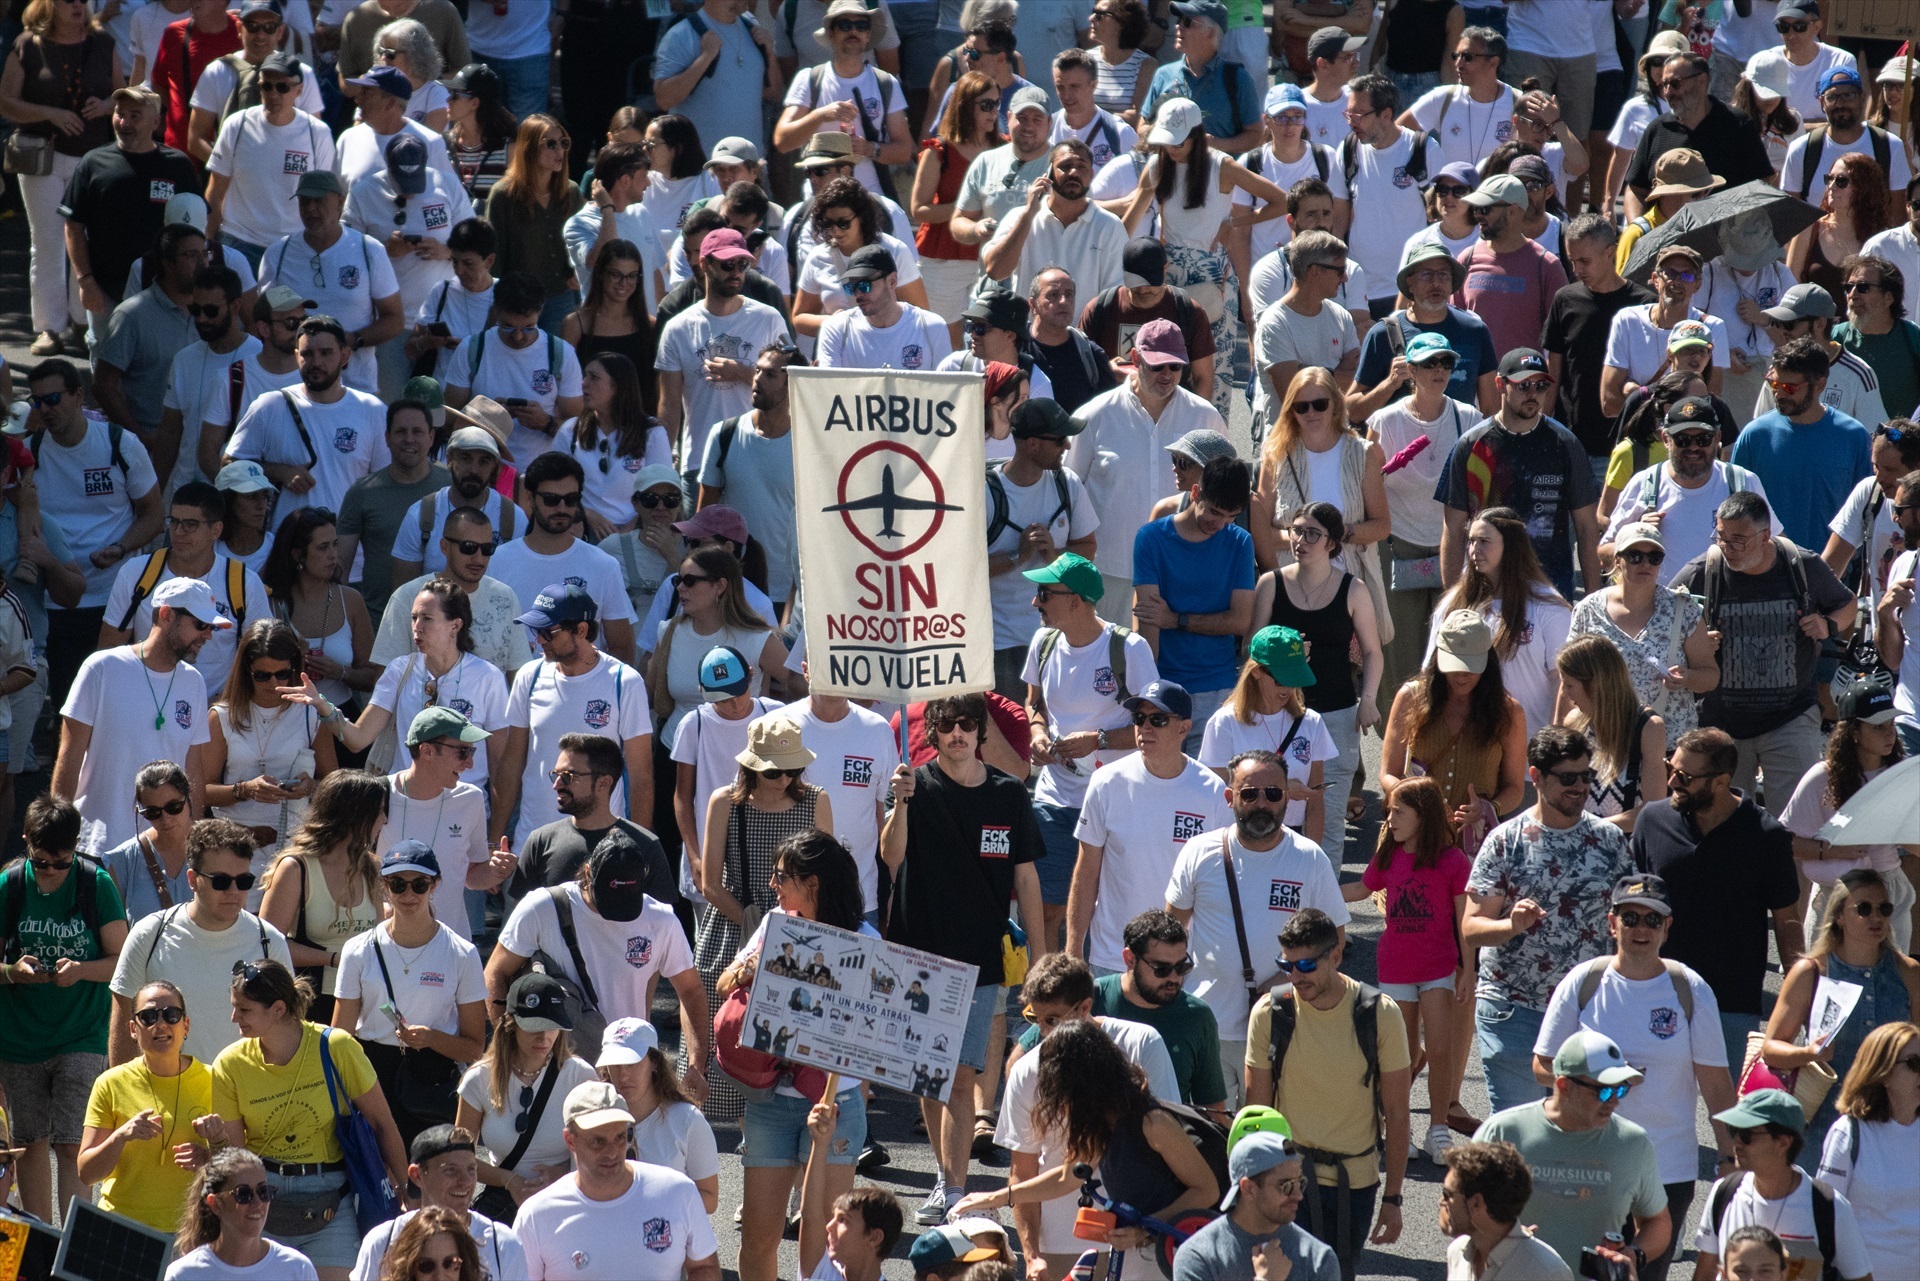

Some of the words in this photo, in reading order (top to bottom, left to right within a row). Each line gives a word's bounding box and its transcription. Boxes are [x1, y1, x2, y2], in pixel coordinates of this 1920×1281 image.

[285, 152, 309, 164] FCK
[283, 161, 308, 173] BRM
[150, 180, 175, 192] FCK
[422, 206, 446, 218] FCK
[424, 214, 449, 228] BRM
[1521, 355, 1543, 366] FILA
[824, 393, 958, 438] AIRBUS
[84, 470, 112, 483] FCK
[1533, 474, 1564, 485] AIRBUS
[84, 480, 114, 494] BRM
[855, 561, 939, 613] SIN
[826, 613, 967, 645] NOSOTR@S
[830, 653, 871, 687] NO
[882, 651, 967, 689] VUELA
[843, 759, 873, 774] FCK
[842, 771, 872, 785] BRM
[1174, 814, 1205, 831] FCK
[981, 829, 1011, 843] FCK
[980, 842, 1010, 855] BRM
[1270, 883, 1302, 898] FCK
[1268, 895, 1301, 910] BRM
[18, 919, 51, 936] CUELA
[52, 919, 88, 938] PÚBLICA
[808, 924, 837, 937] BENEFICIOS
[928, 963, 942, 973] LIBRE
[821, 991, 836, 1003] ¡NI
[838, 997, 852, 1009] UN
[854, 1001, 878, 1015] PASO
[880, 1007, 912, 1024] ATRÁS!
[249, 1097, 268, 1105] SOMOS
[302, 1080, 326, 1090] INFANCIA
[1532, 1165, 1613, 1182] QUIKSILVER
